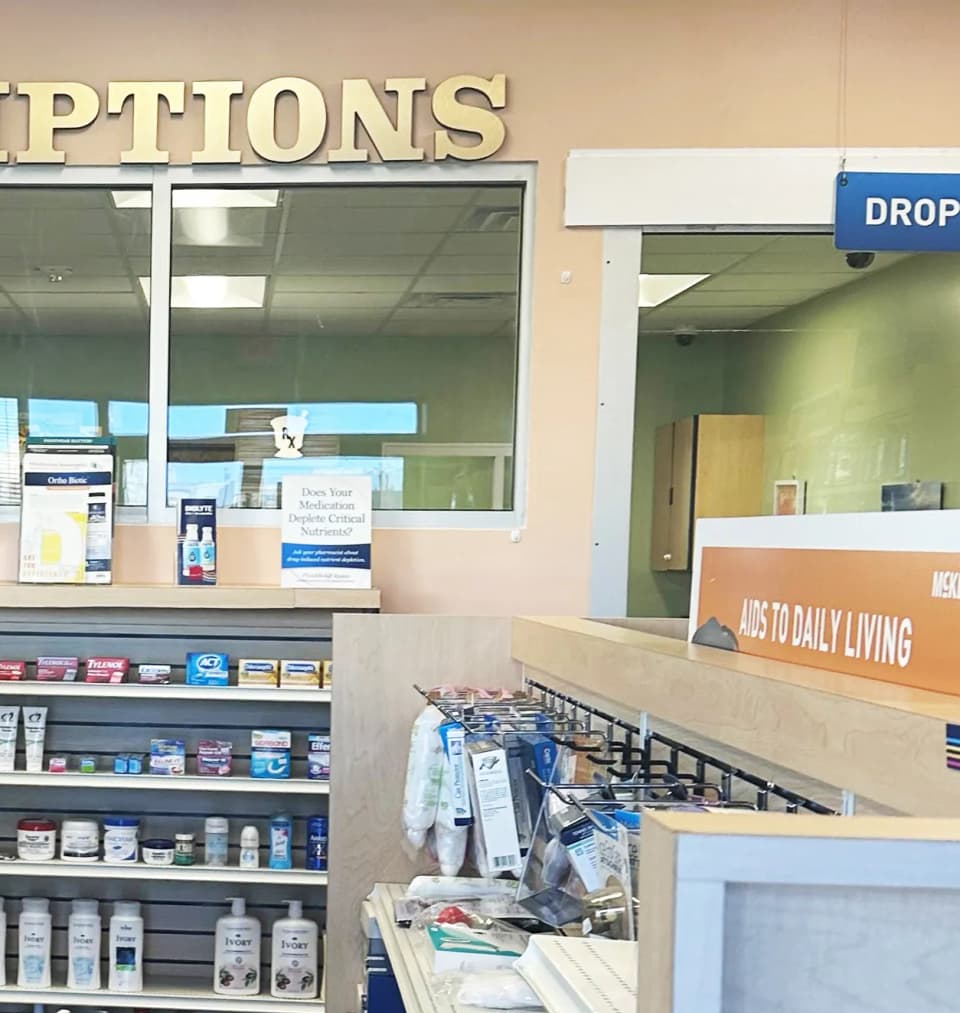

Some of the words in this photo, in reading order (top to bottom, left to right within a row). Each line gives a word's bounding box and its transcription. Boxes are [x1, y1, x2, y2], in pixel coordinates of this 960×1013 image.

[865, 197, 960, 227] DROP
[302, 487, 327, 497] Does
[329, 487, 353, 497] Your
[298, 500, 355, 510] Medication
[288, 513, 326, 525] Deplete
[328, 513, 366, 524] Critical
[300, 527, 353, 537] Nutrients?
[739, 598, 769, 640] AIDS
[771, 602, 789, 644] TO
[792, 604, 842, 654] DAILY
[844, 611, 913, 668] LIVING
[87, 658, 124, 670] TYLENOL
[198, 656, 218, 667] ACT
[73, 936, 94, 944] IVORY
[115, 935, 136, 943] IVORY
[225, 937, 253, 946] IVORY
[281, 940, 310, 949] IVORY
